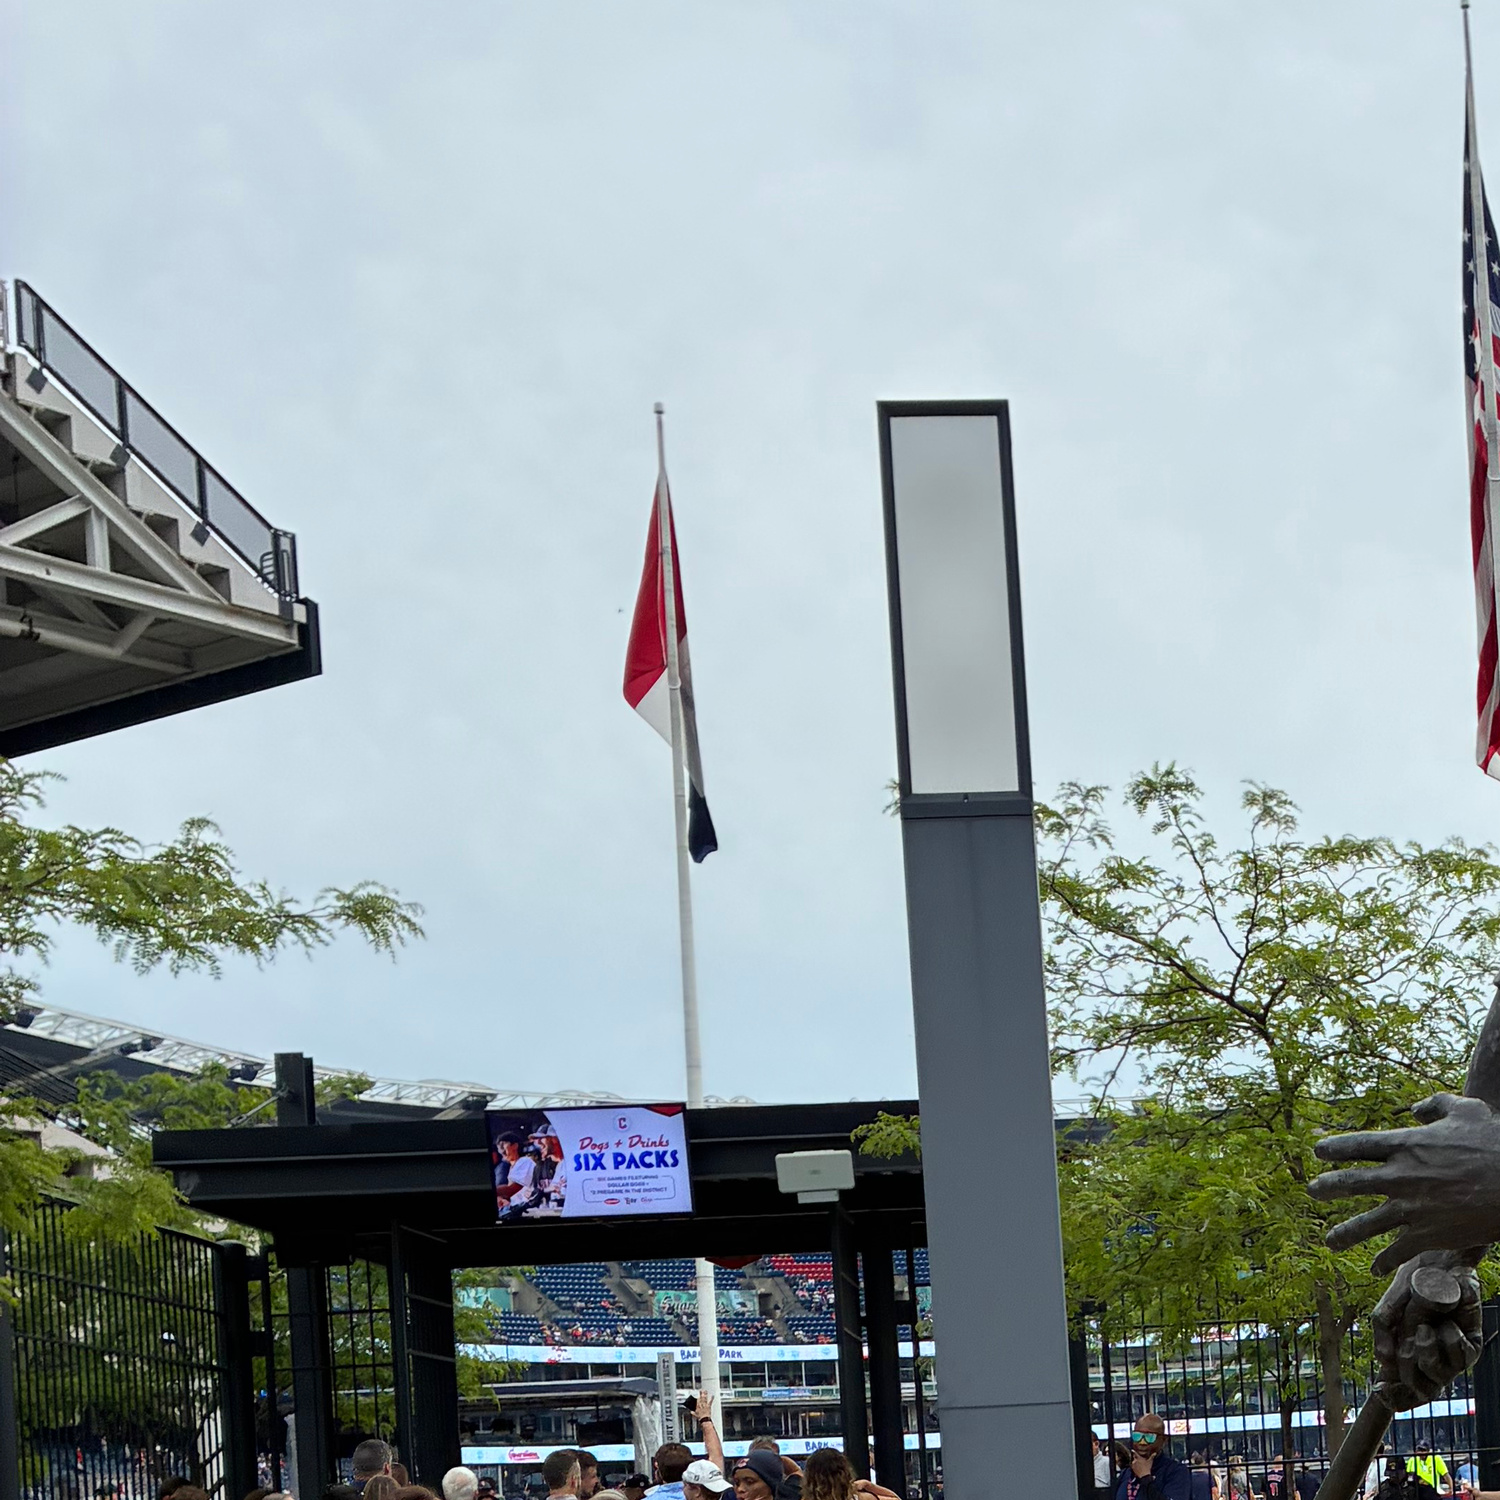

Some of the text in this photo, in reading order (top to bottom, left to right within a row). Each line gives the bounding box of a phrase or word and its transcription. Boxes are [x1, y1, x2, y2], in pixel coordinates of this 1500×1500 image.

[579, 1136, 610, 1155] Dogs
[628, 1134, 670, 1149] Drinks
[573, 1149, 680, 1172] SIX PACKS
[680, 1348, 743, 1360] BAR PARK
